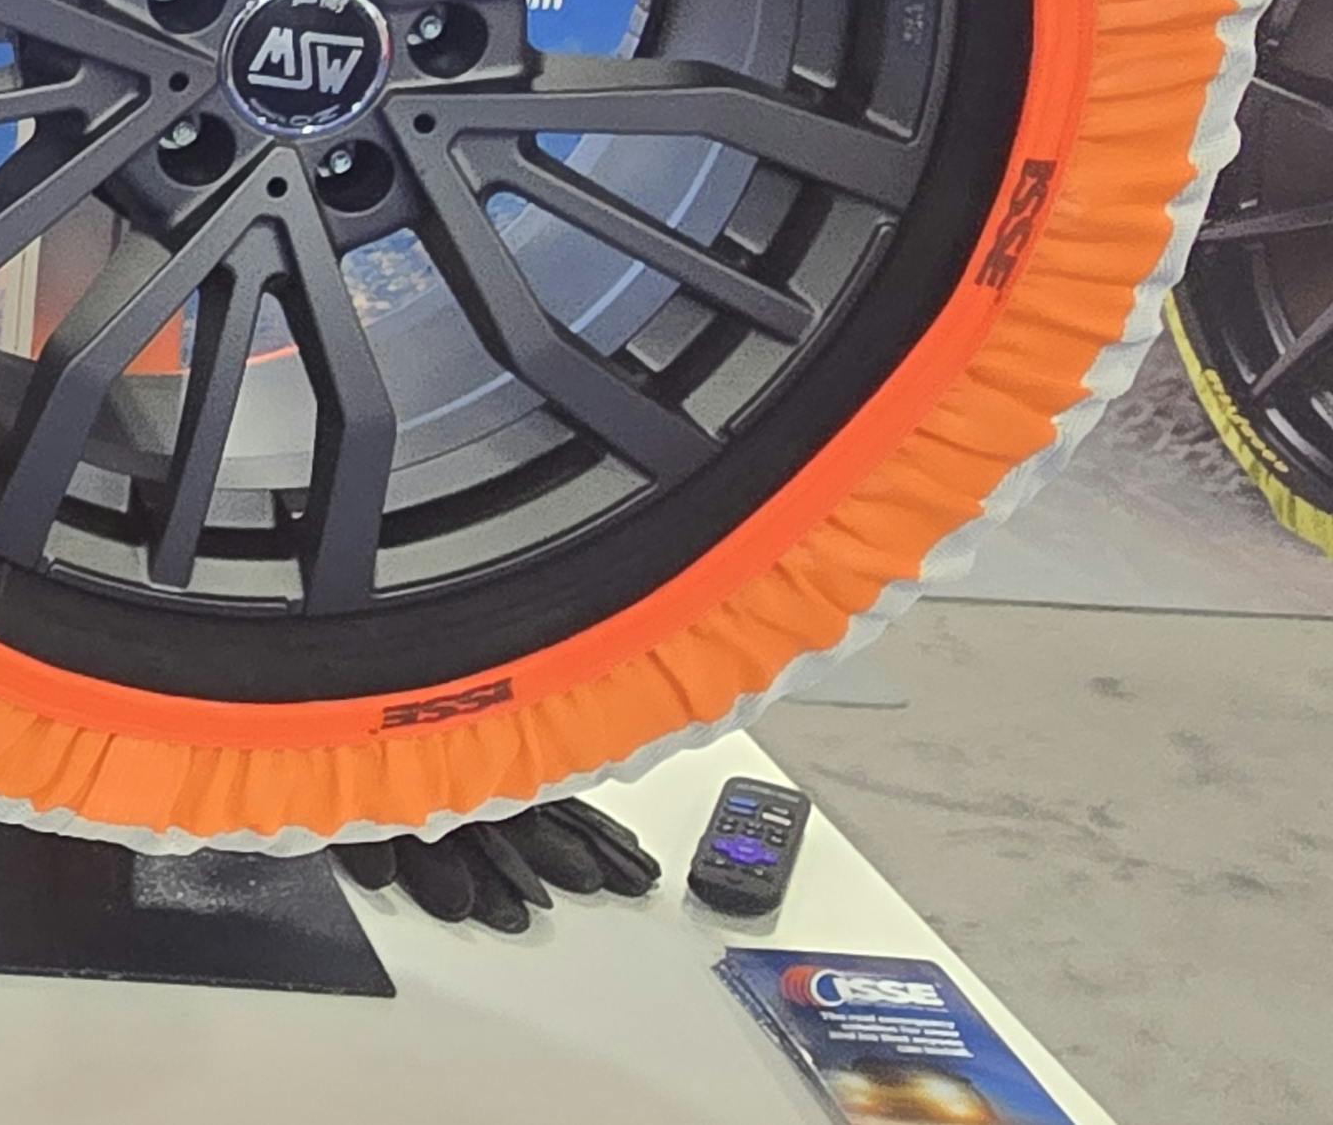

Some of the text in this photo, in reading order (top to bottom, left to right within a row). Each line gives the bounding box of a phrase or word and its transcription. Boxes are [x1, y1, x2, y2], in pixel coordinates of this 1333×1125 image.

[247, 27, 364, 94] MSW
[974, 158, 1057, 290] ISSE
[380, 677, 515, 731] ISSE
[833, 976, 945, 1007] ISSE
